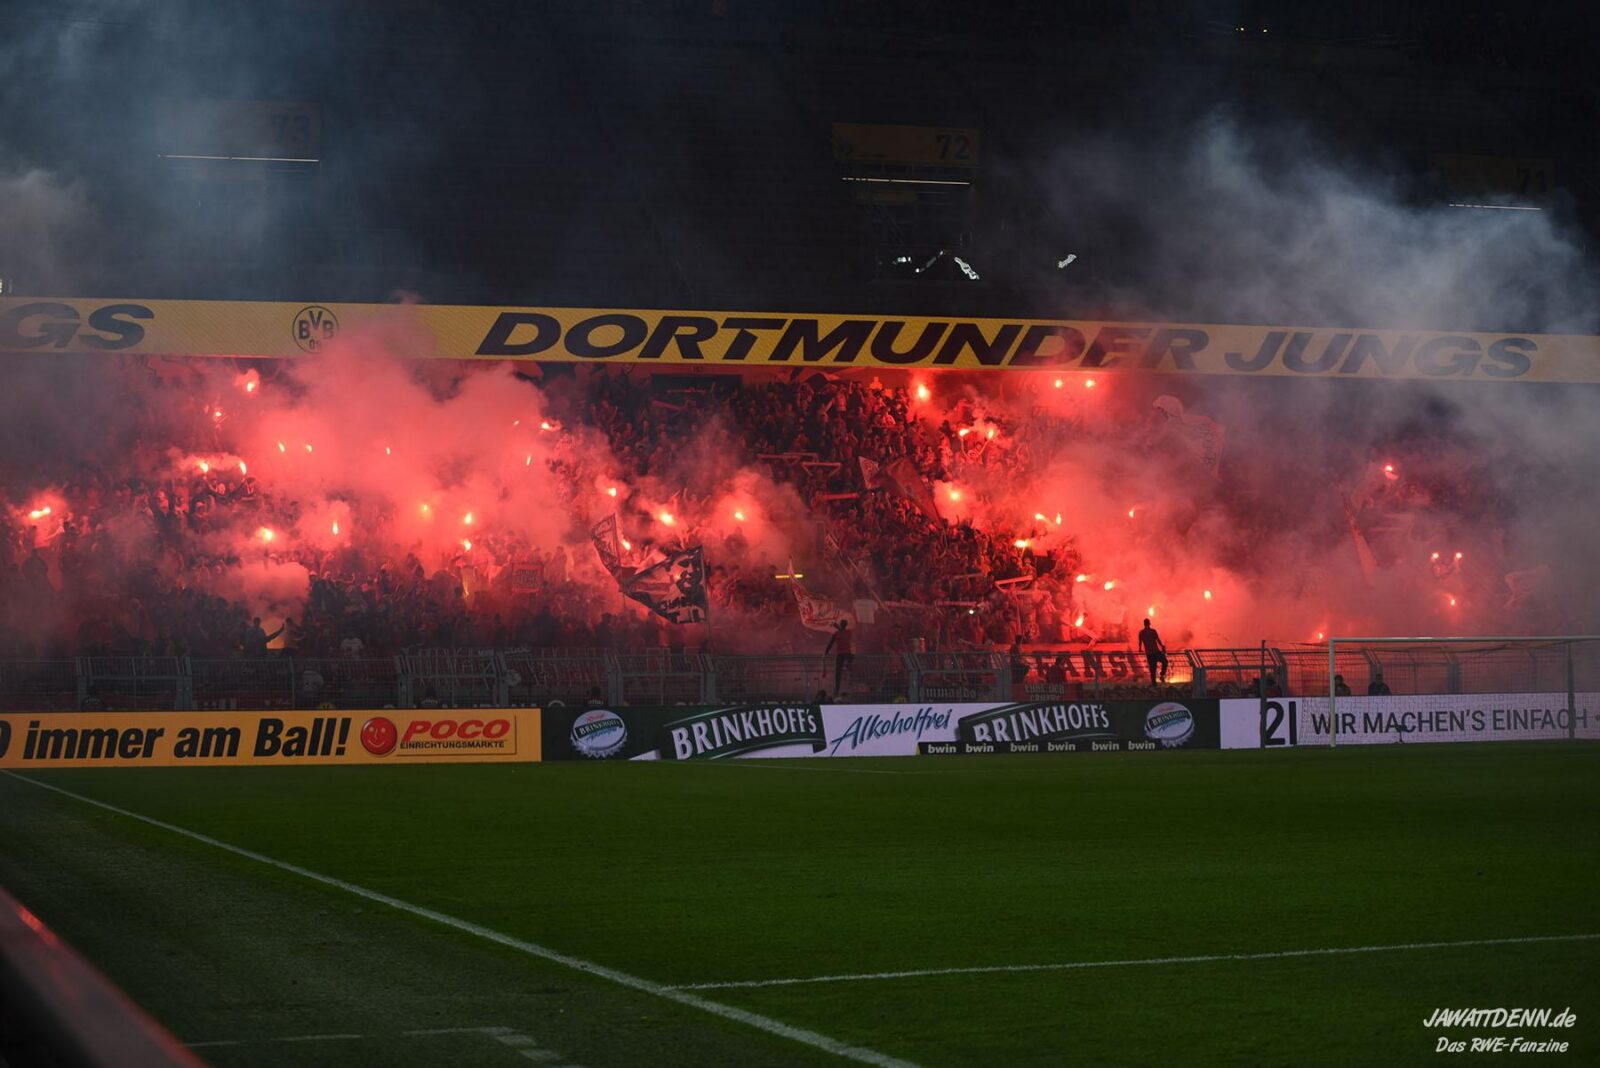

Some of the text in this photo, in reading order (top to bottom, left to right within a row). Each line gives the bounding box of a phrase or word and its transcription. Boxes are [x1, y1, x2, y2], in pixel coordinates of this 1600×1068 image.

[935, 134, 970, 160] 72
[298, 310, 334, 340] BVB
[475, 311, 1538, 377] DORTMUNDER JUNGS
[401, 719, 511, 743] POCO
[831, 707, 952, 756] Alkoholfrei
[1313, 713, 1356, 735] WIR
[1493, 708, 1587, 730] EINFACH
[23, 721, 164, 759] immer
[174, 727, 241, 757] am
[253, 718, 351, 757] Ball!
[928, 740, 1155, 753] bwin bwin bwin bwin bwin bwin
